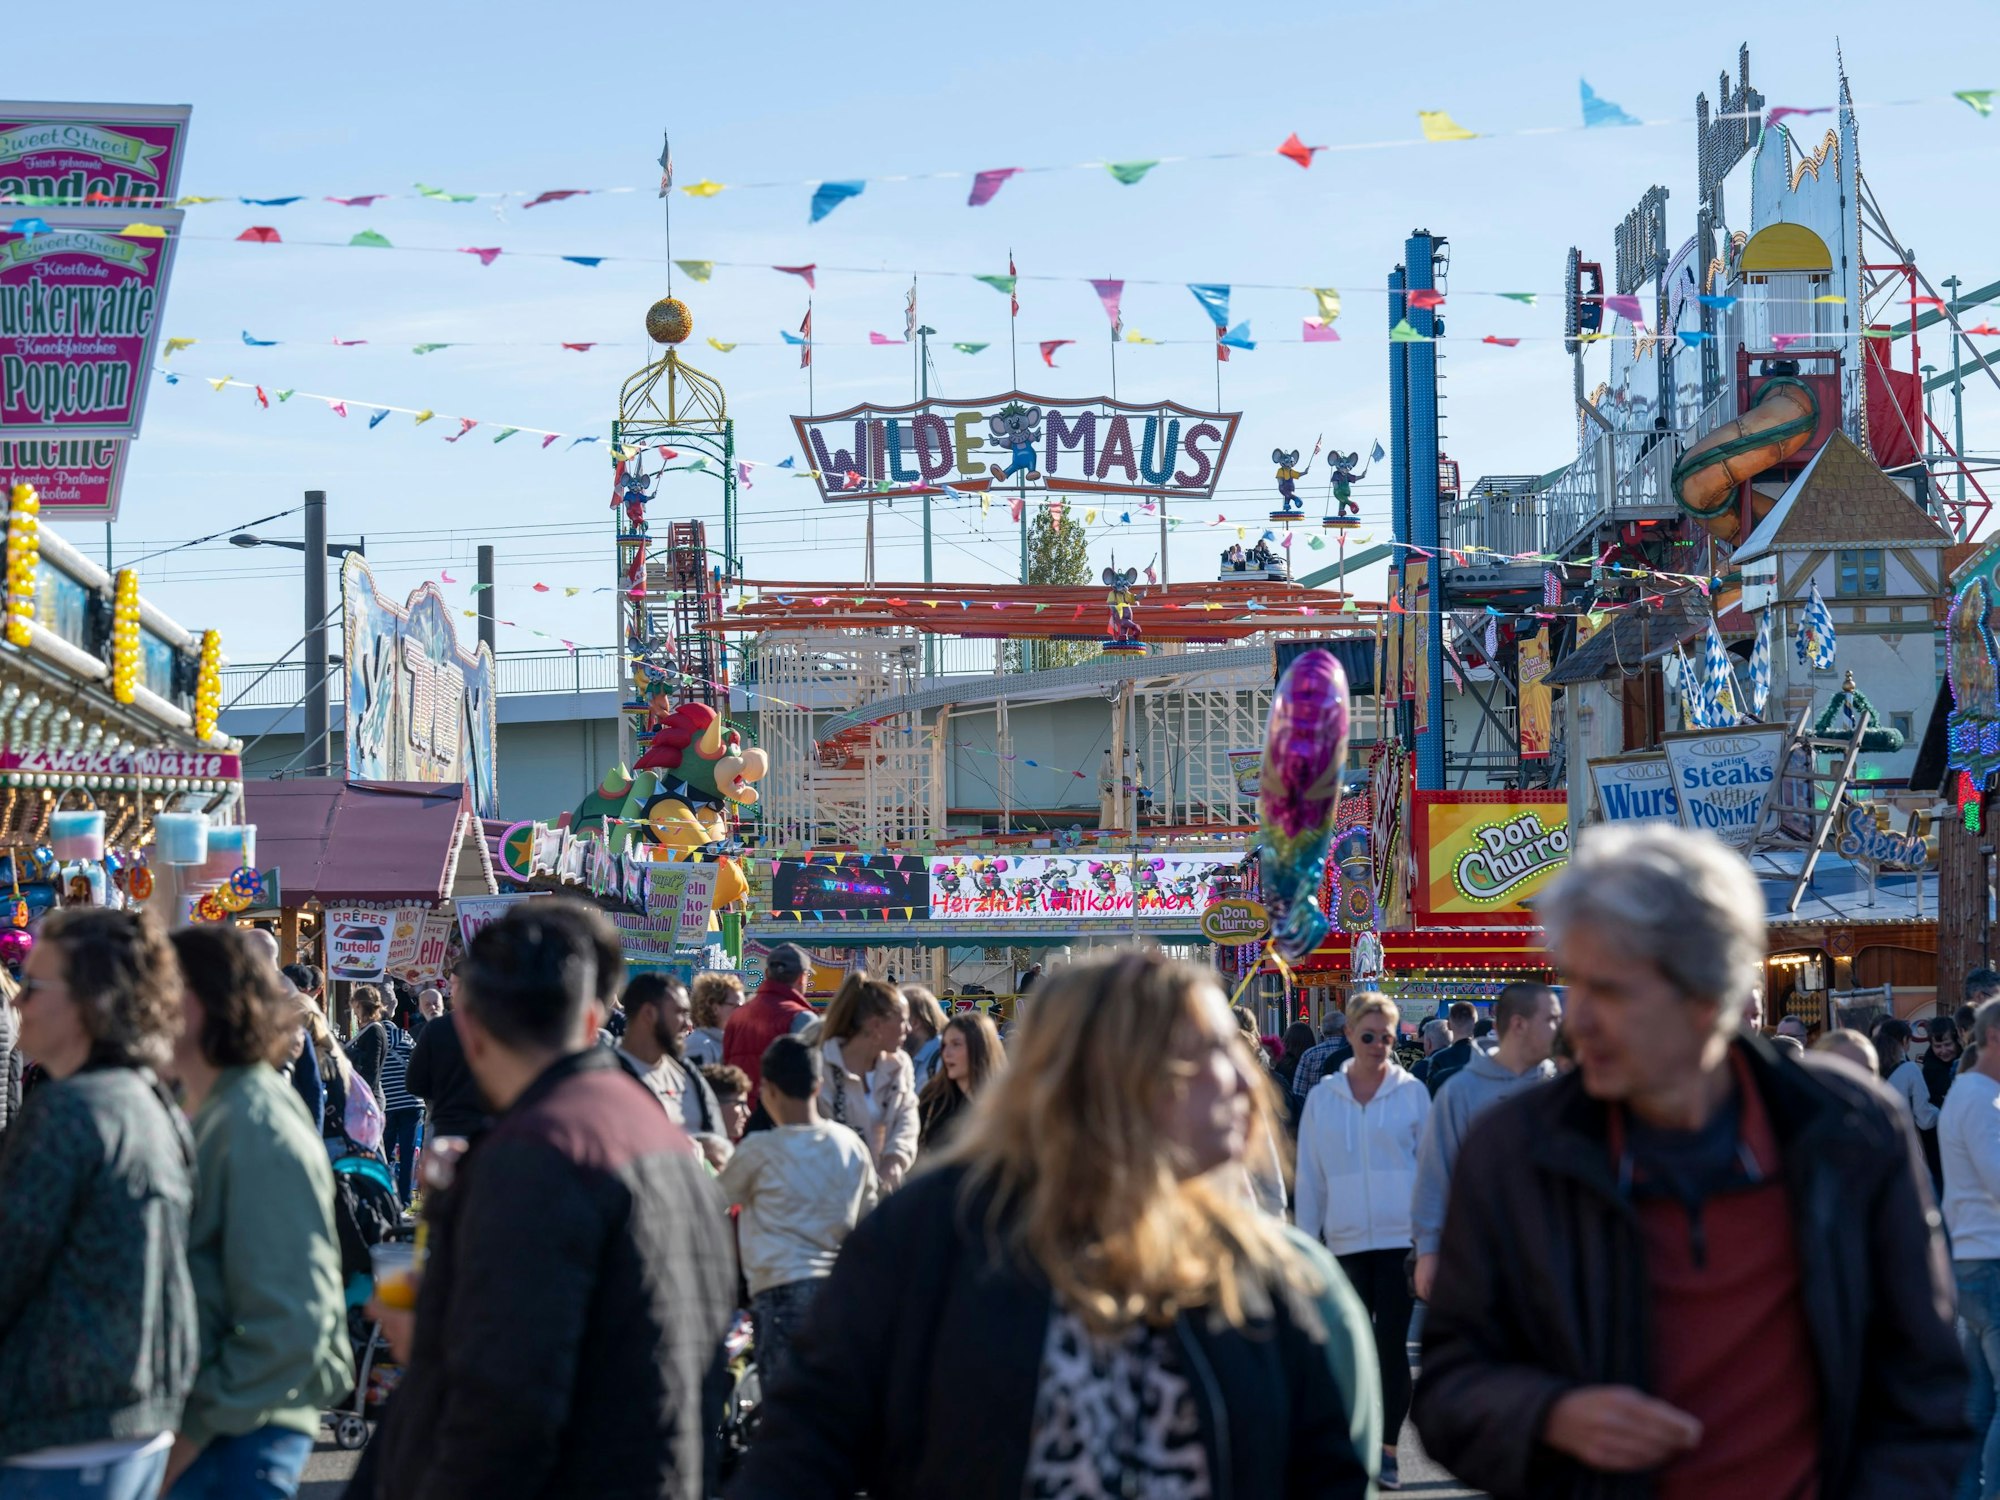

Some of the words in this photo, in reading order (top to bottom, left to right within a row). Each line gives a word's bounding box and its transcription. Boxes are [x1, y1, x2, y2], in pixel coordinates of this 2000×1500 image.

[33, 262, 109, 277] Köstliche
[14, 338, 117, 358] Knackfrisches
[3, 355, 129, 422] Popcorn
[809, 411, 987, 492] WILDE
[1045, 409, 1222, 488] MAUS
[19, 747, 222, 776] Zuckerwatte
[1711, 756, 1747, 769] Saftige
[1683, 763, 1774, 789] Steaks
[1478, 816, 1542, 856] Don
[1458, 825, 1567, 898] Churro
[932, 889, 1031, 913] Herzlich
[1042, 888, 1194, 913] Willkommen
[1223, 906, 1248, 918] Don
[333, 910, 388, 926] CRÊPES
[613, 911, 673, 932] Blumenkohl
[1206, 912, 1265, 935] Churros
[1345, 919, 1375, 931] POLICE
[335, 940, 381, 954] nutella
[414, 937, 444, 966] eln
